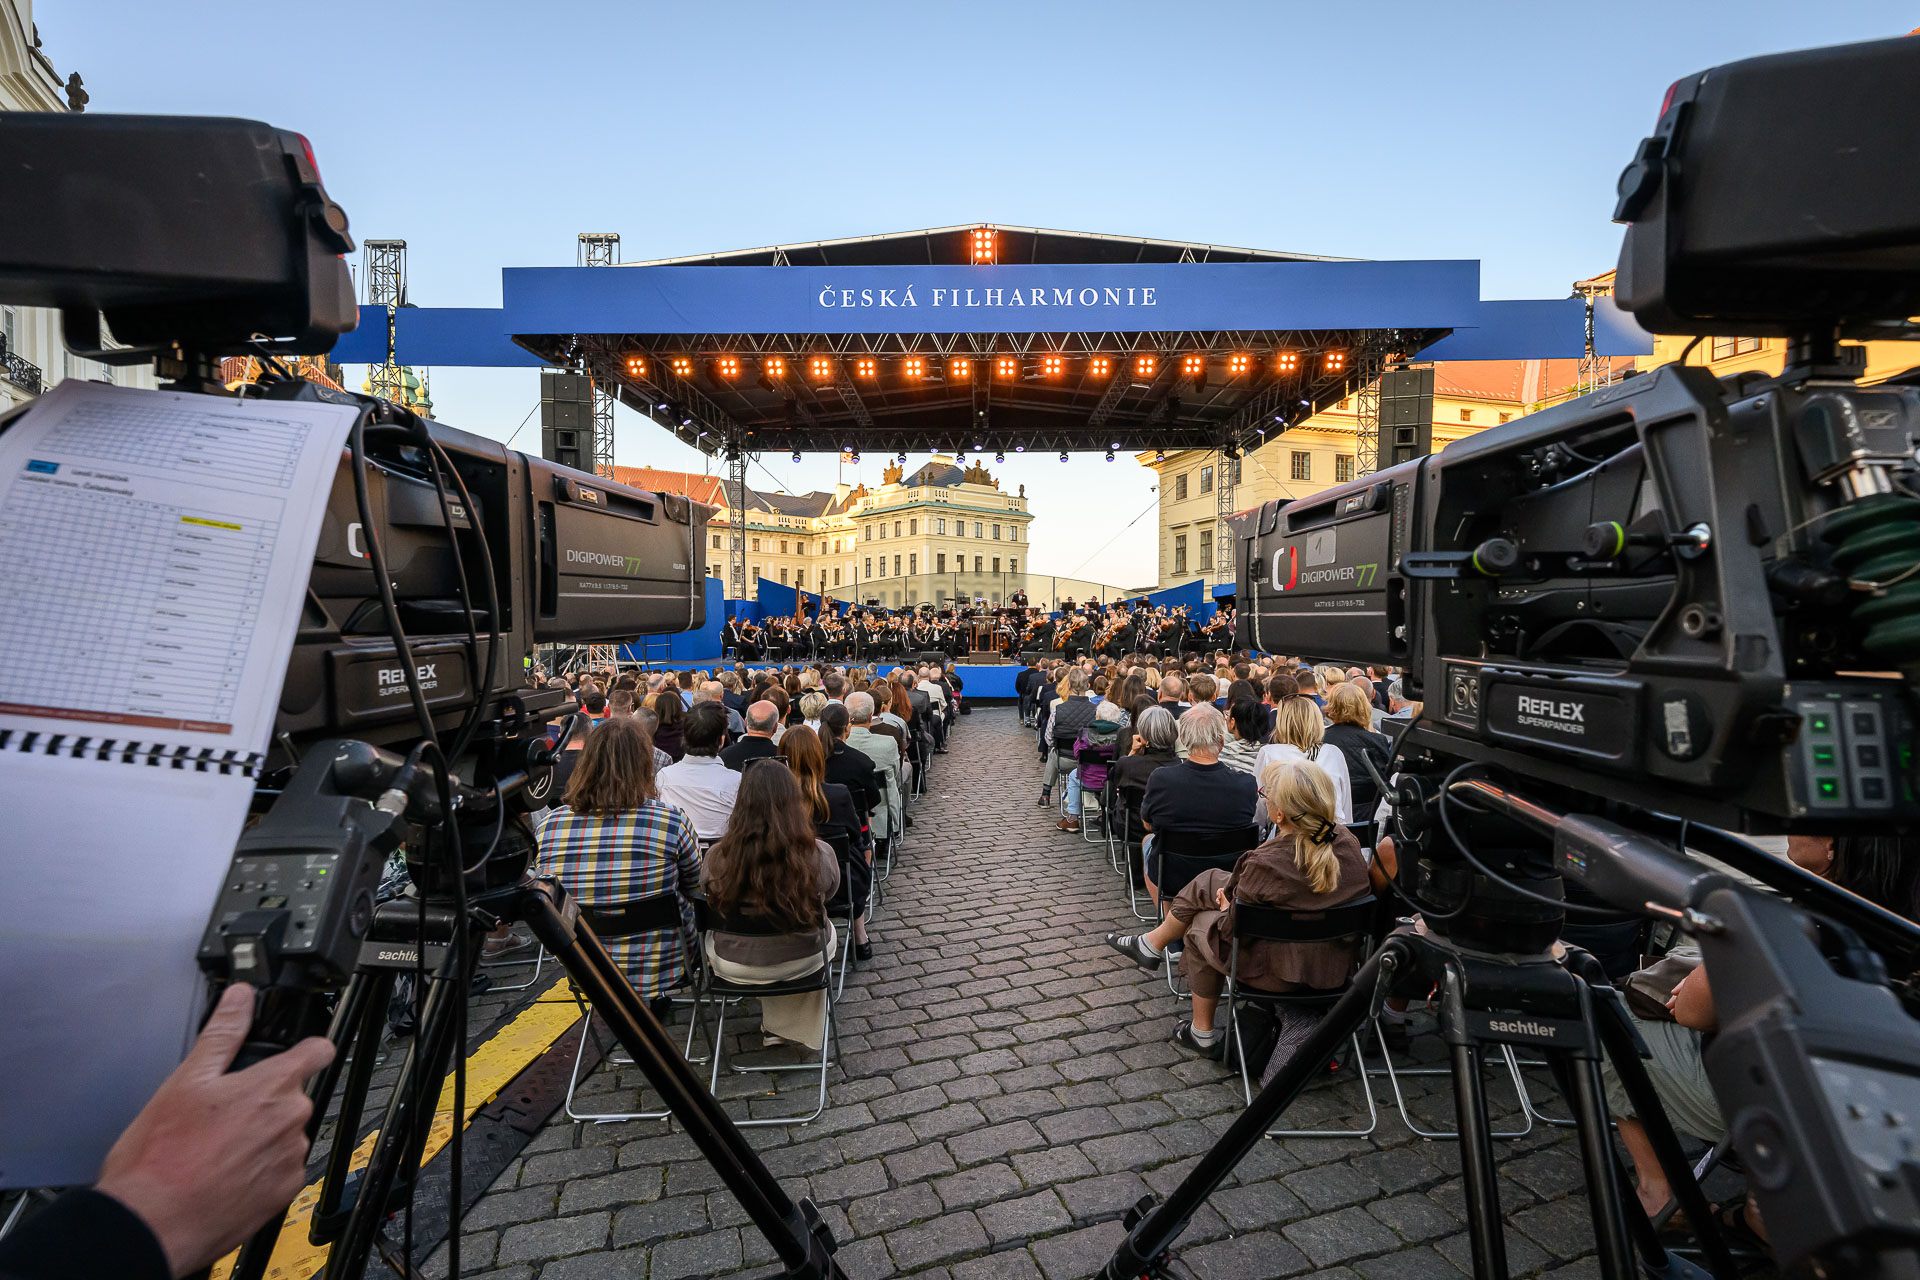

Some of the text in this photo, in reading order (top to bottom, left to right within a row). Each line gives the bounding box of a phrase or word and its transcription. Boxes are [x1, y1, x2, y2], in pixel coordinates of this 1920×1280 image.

[818, 284, 1157, 307] ČESKÁ FILHARMONIE
[566, 549, 641, 575] DIGIPOWER 77
[1301, 563, 1378, 588] DIGIPOWER 77
[378, 663, 437, 685] REFEX
[1518, 695, 1584, 722] REFLEX
[1517, 714, 1585, 735] SUPERXPANDER
[378, 950, 419, 961] sachtle
[1489, 1020, 1556, 1037] sachtler
